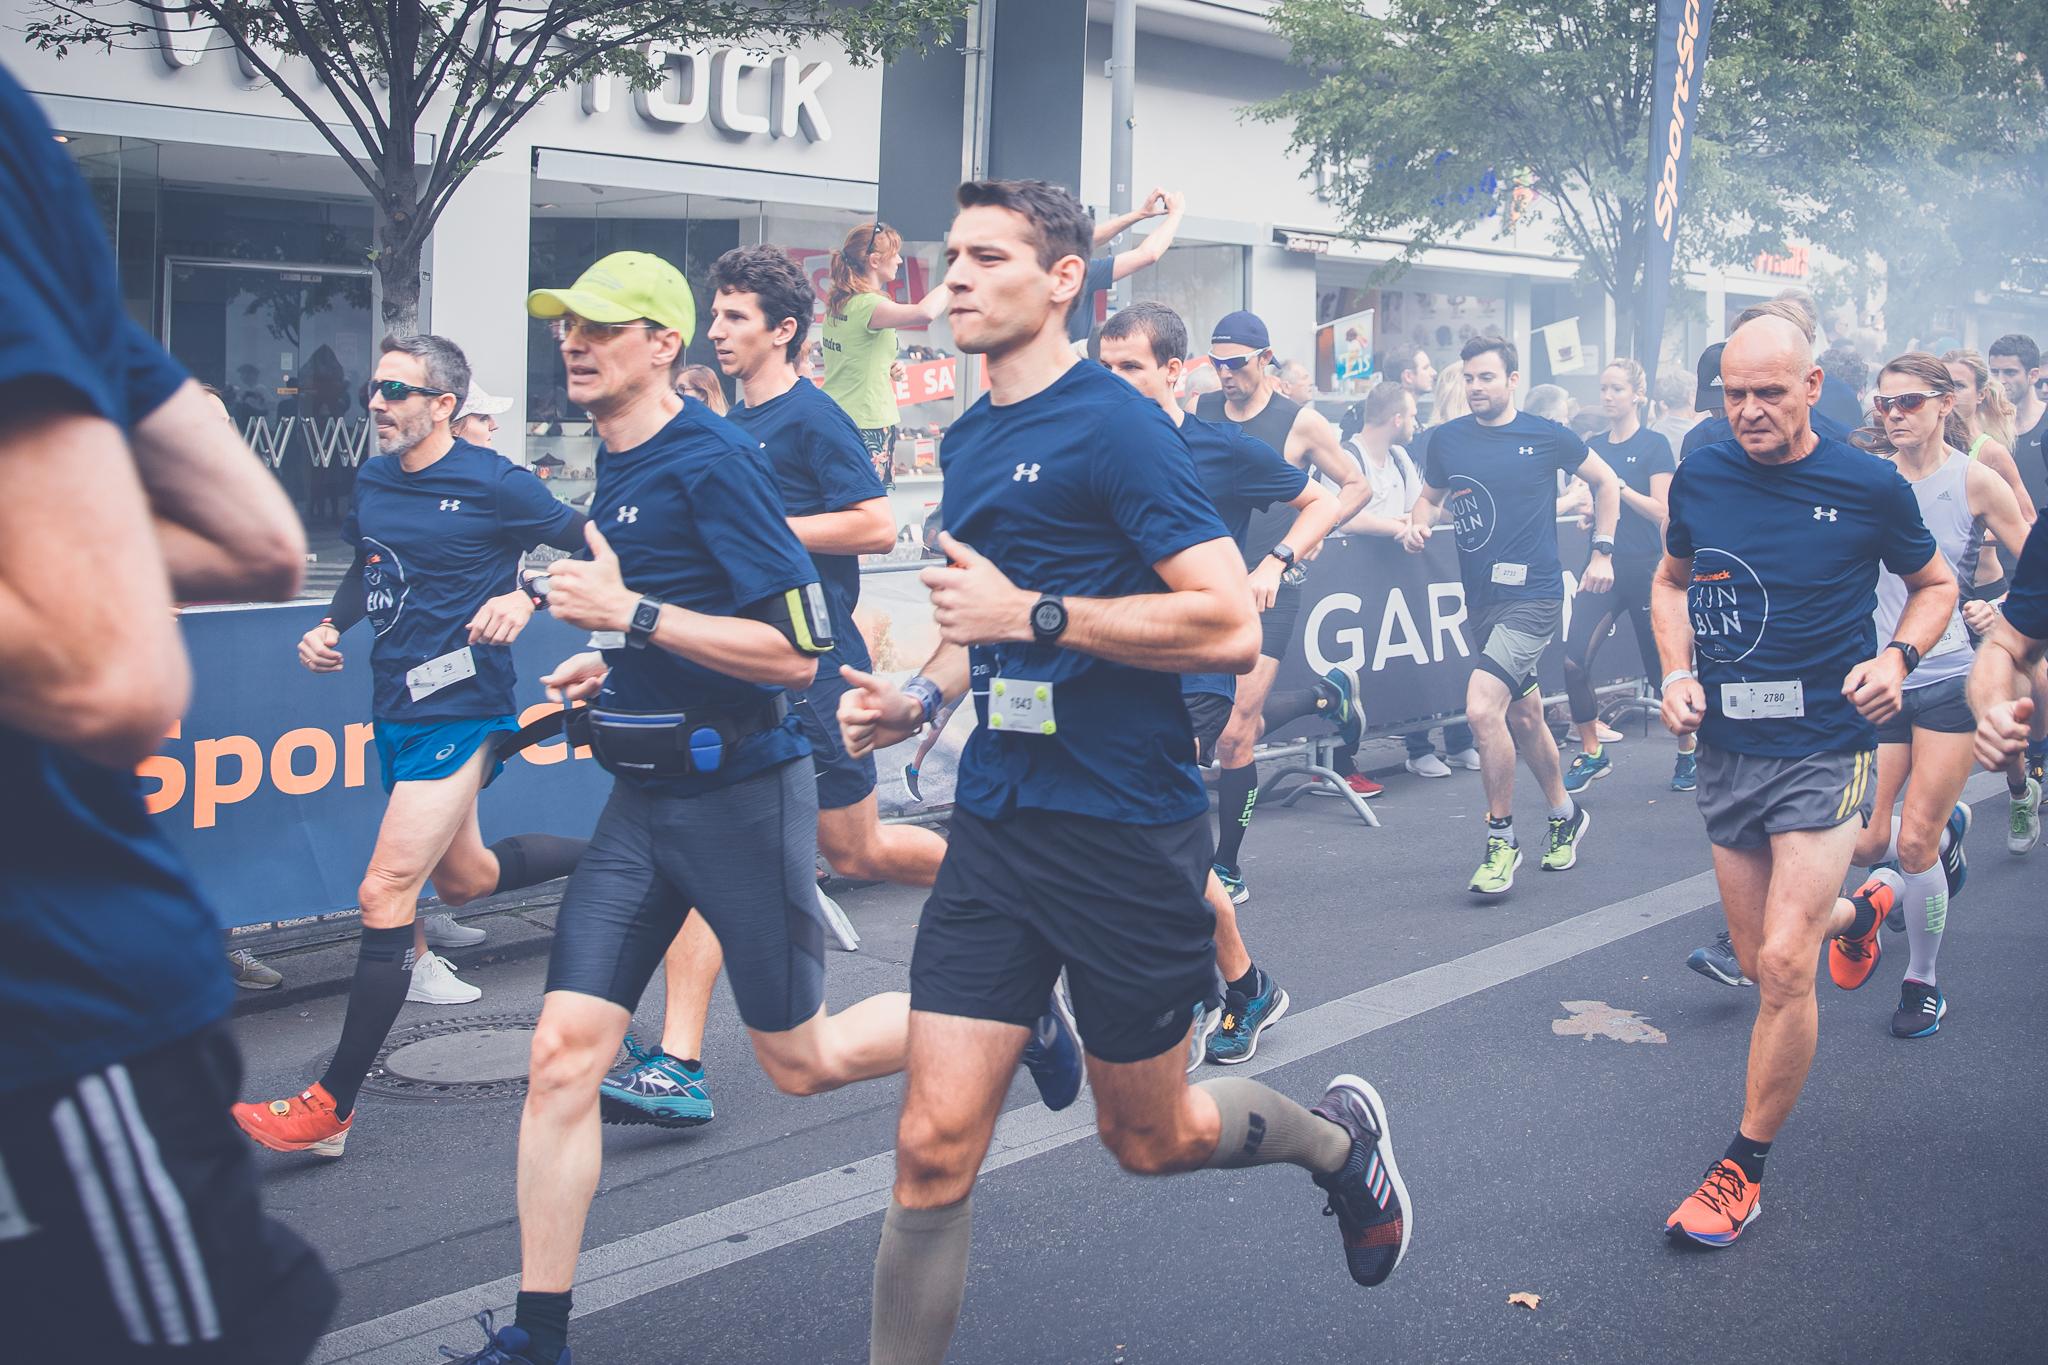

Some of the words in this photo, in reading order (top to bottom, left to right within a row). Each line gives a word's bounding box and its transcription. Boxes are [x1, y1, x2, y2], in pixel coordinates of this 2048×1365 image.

[923, 365, 956, 396] SA
[1453, 513, 1484, 535] BLN
[1694, 610, 1743, 636] BLN
[1763, 692, 1785, 703] 2780
